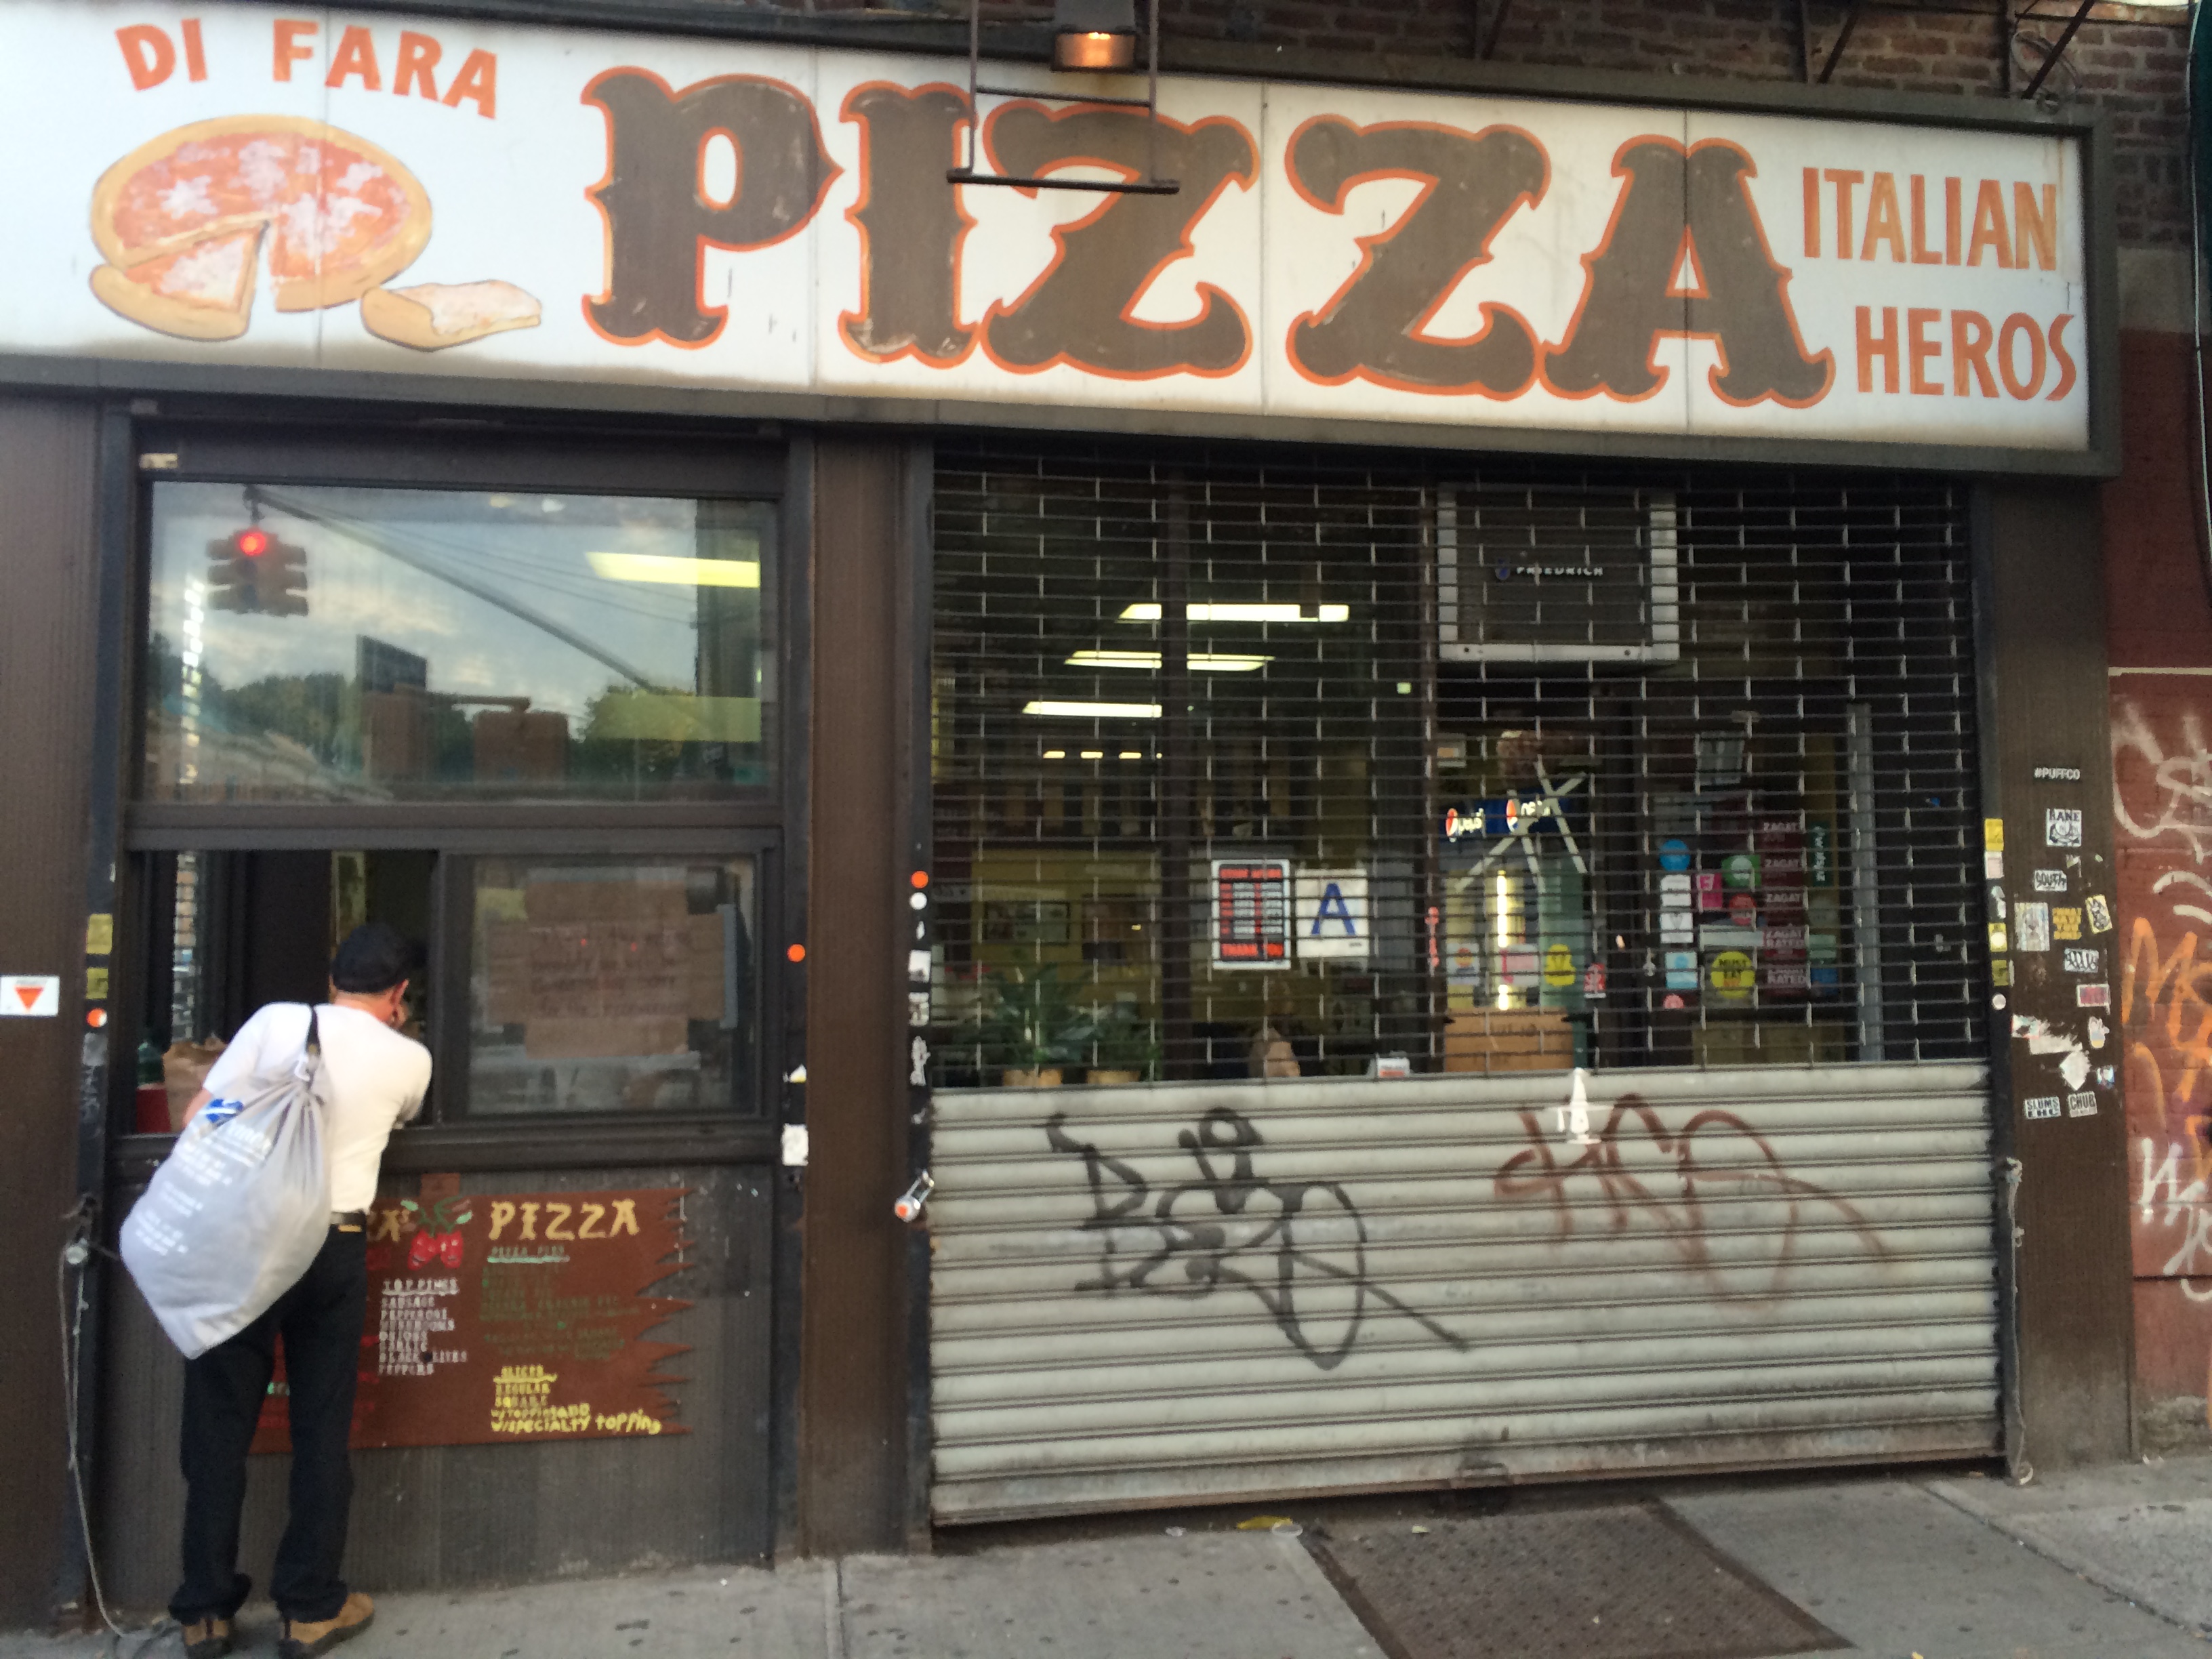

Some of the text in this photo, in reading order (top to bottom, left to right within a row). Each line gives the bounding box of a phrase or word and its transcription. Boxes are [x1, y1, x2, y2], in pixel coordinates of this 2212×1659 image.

[116, 18, 497, 119] DI FARA
[581, 65, 1835, 409] PIZZA
[1802, 167, 2057, 272] ITALIAN
[1855, 306, 2078, 402] HEROS
[1311, 882, 1357, 936] A
[488, 1198, 640, 1241] PIZZA
